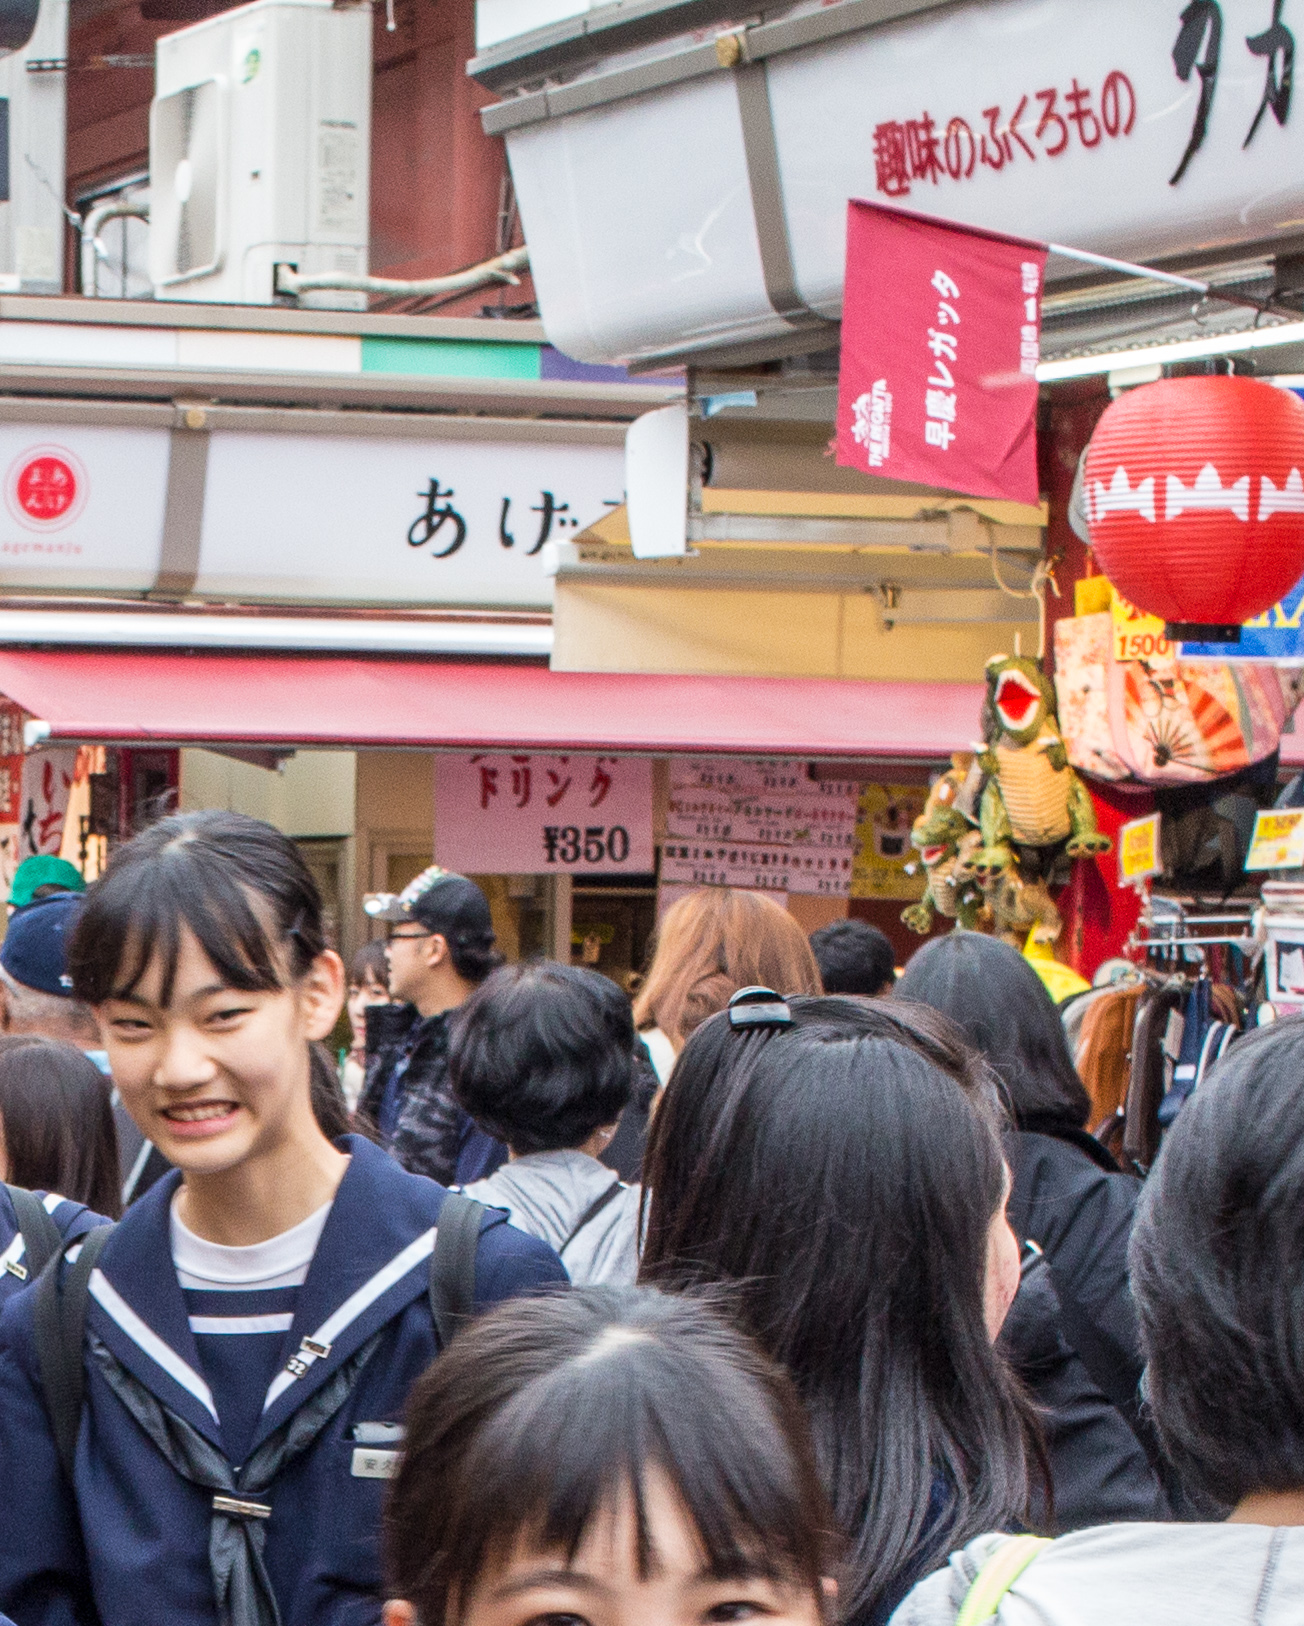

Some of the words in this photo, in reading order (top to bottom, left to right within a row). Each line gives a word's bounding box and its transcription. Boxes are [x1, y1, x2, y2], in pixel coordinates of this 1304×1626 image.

[872, 70, 1137, 197] 趣味のふくろもの
[925, 269, 961, 451] 早慶レガッタ
[407, 477, 627, 559] あげ
[543, 825, 631, 863] ¥350
